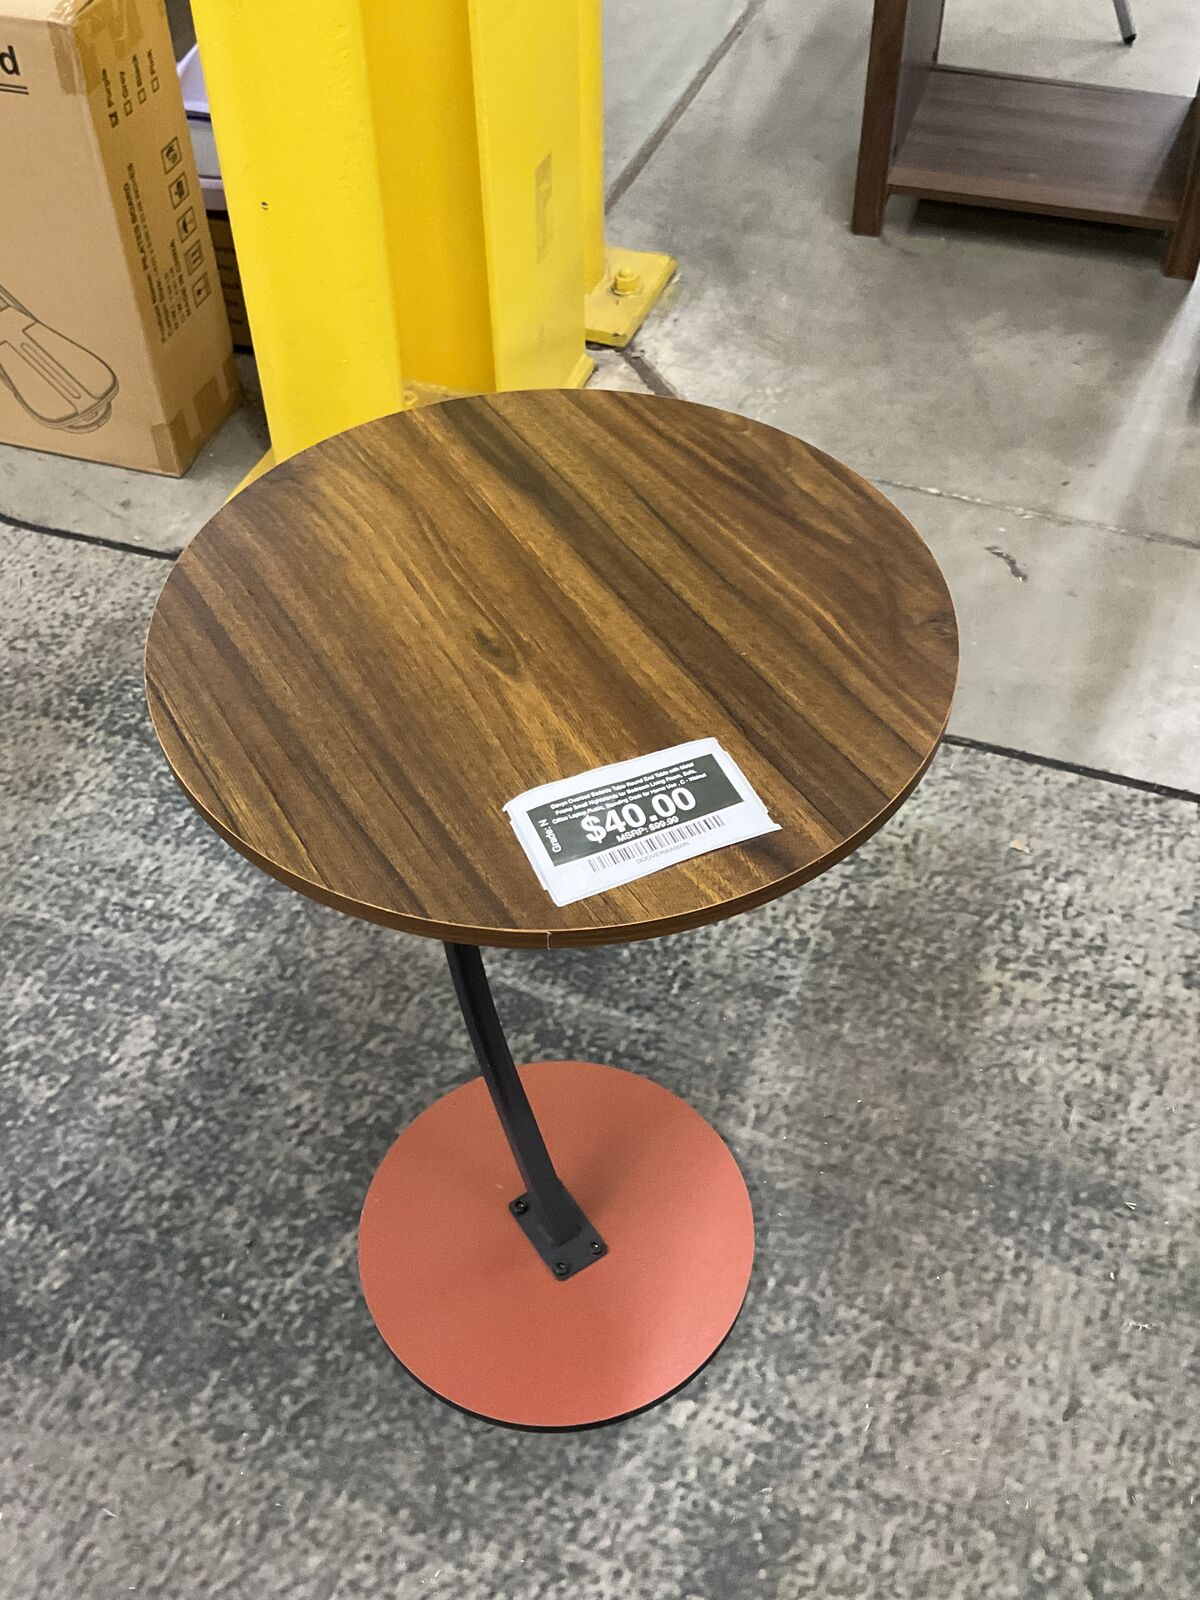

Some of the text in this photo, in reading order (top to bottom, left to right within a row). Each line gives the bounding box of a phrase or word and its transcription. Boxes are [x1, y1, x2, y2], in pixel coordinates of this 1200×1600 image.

[99, 68, 114, 108] Purple
[123, 182, 137, 224] BOARD
[133, 224, 149, 271] PILATES
[625, 778, 643, 786] Round
[538, 818, 561, 852] Grade: N
[581, 787, 696, 843] $40.00
[615, 815, 678, 842] MSRP: $99.99
